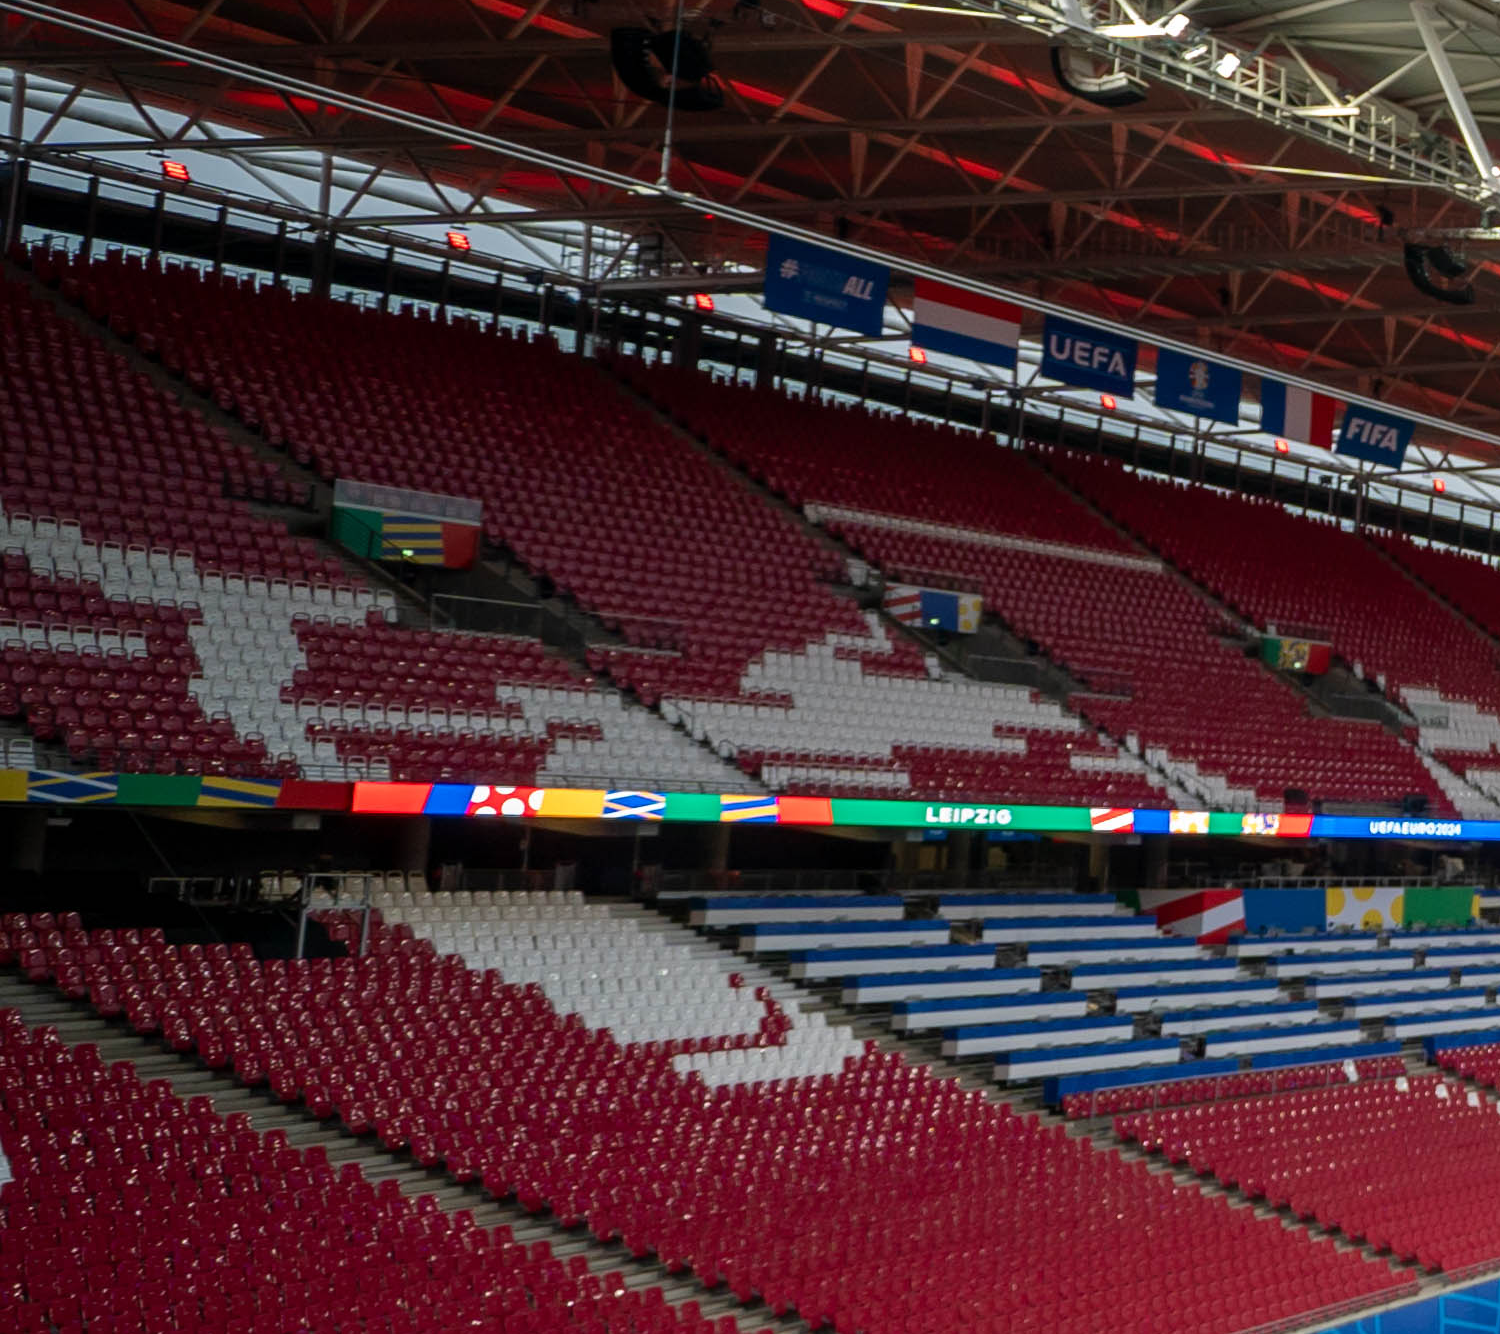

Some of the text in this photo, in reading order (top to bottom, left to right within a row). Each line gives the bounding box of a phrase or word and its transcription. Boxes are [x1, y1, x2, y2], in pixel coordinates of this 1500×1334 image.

[1050, 334, 1127, 378] UEFA
[1346, 417, 1398, 452] FIFA
[925, 806, 1012, 825] LEIPZIG
